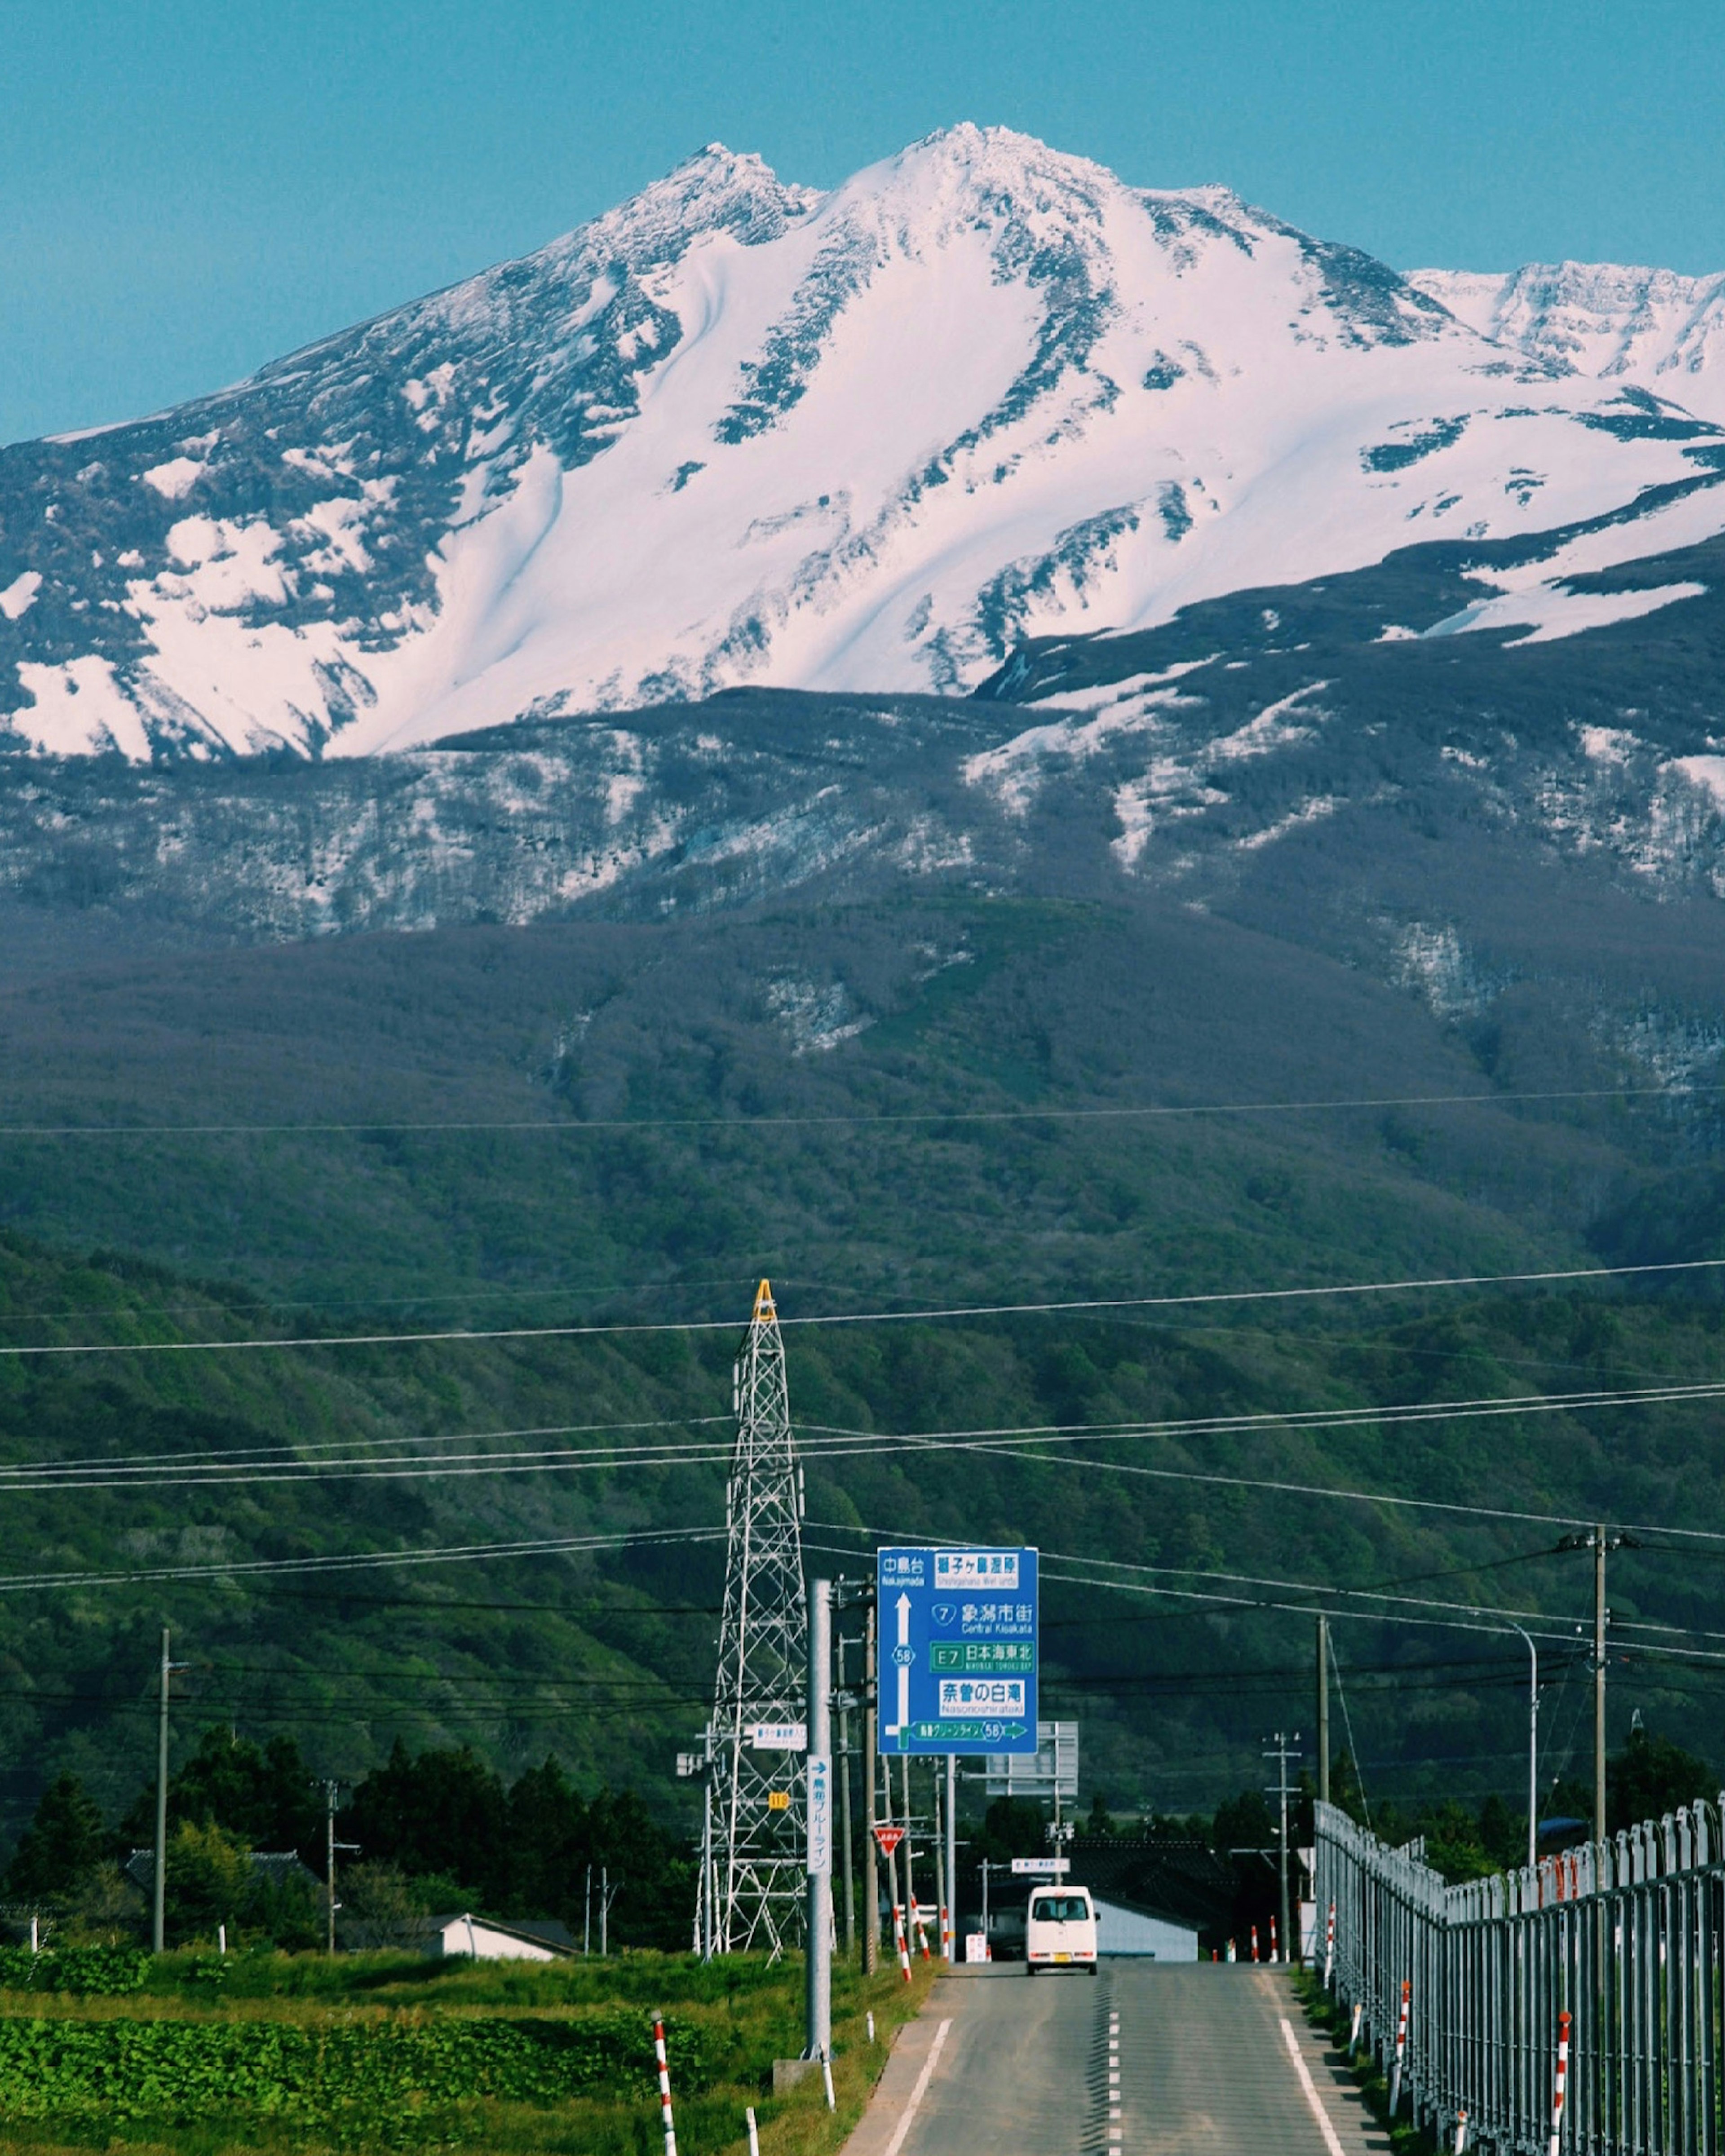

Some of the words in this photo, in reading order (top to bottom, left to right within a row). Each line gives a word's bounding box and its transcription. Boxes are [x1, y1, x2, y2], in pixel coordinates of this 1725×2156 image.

[884, 1556, 924, 1573] 中島台
[940, 1608, 948, 1620] 7
[962, 1604, 1032, 1622] 象潟市街
[962, 1623, 992, 1634] Central
[897, 1649, 911, 1662] 58
[938, 1651, 958, 1664] E7
[967, 1644, 1032, 1661] 日本海東北
[986, 1724, 1000, 1737] 58
